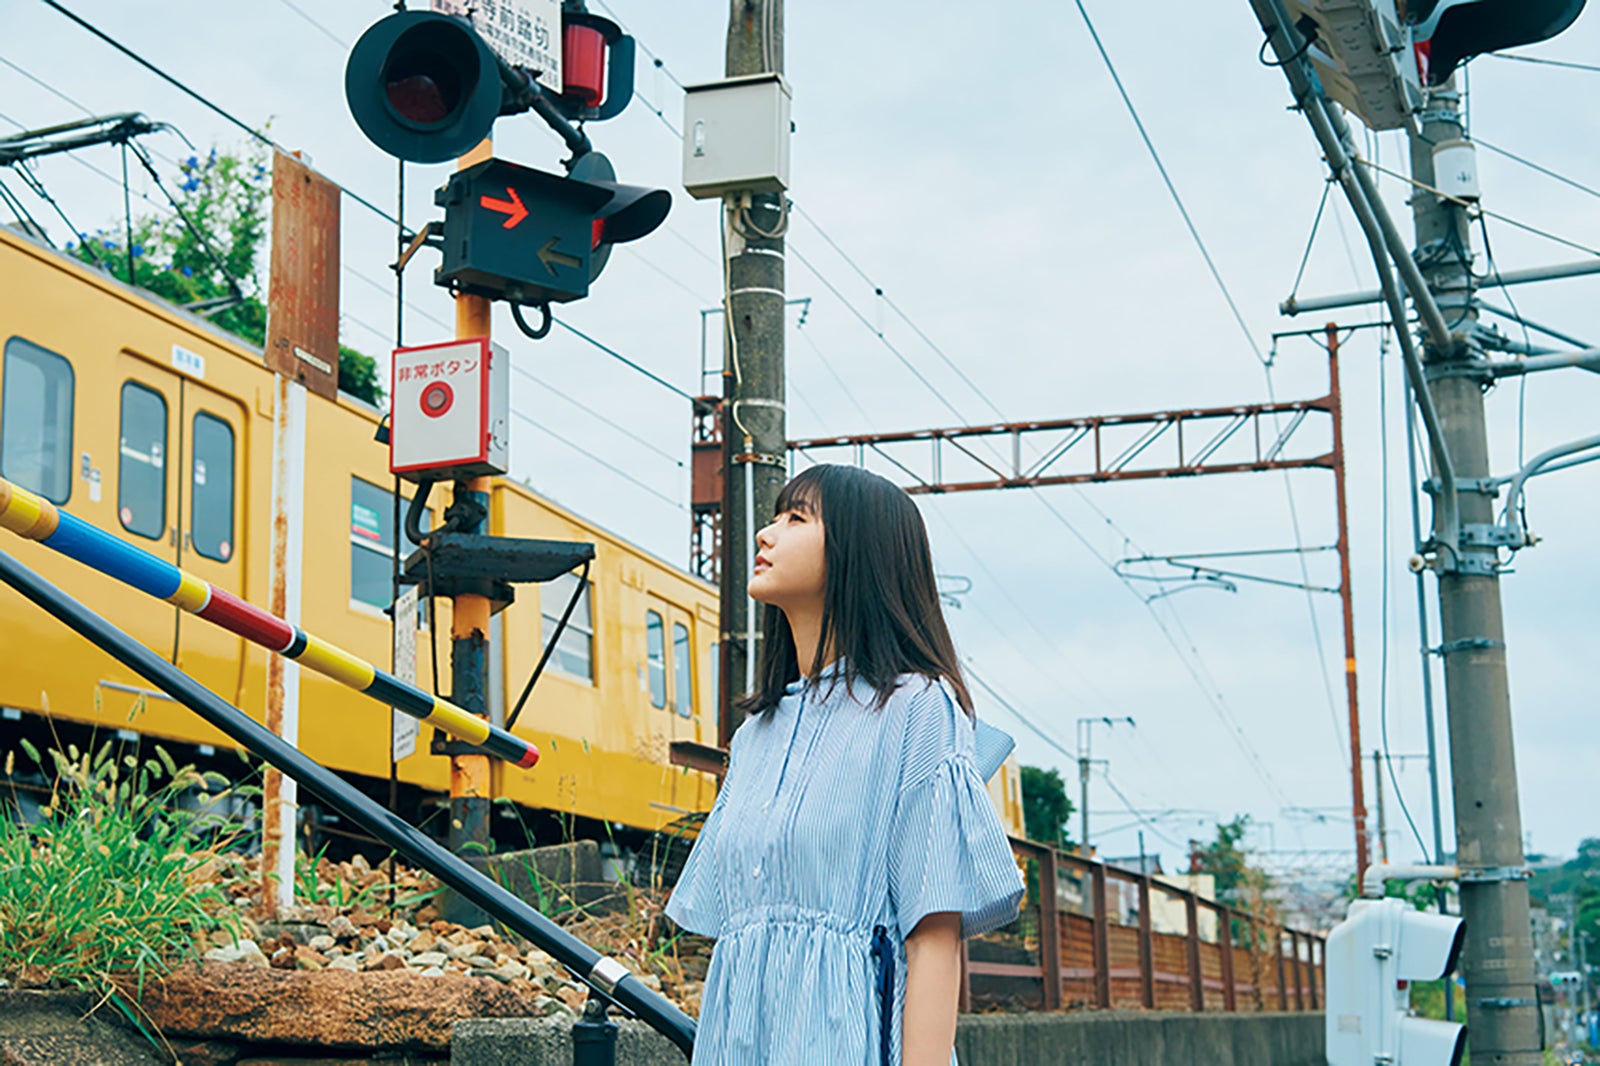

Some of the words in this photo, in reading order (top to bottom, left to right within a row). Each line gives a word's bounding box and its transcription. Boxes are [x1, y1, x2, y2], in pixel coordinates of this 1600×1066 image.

[398, 358, 478, 382] 非常ボタン
